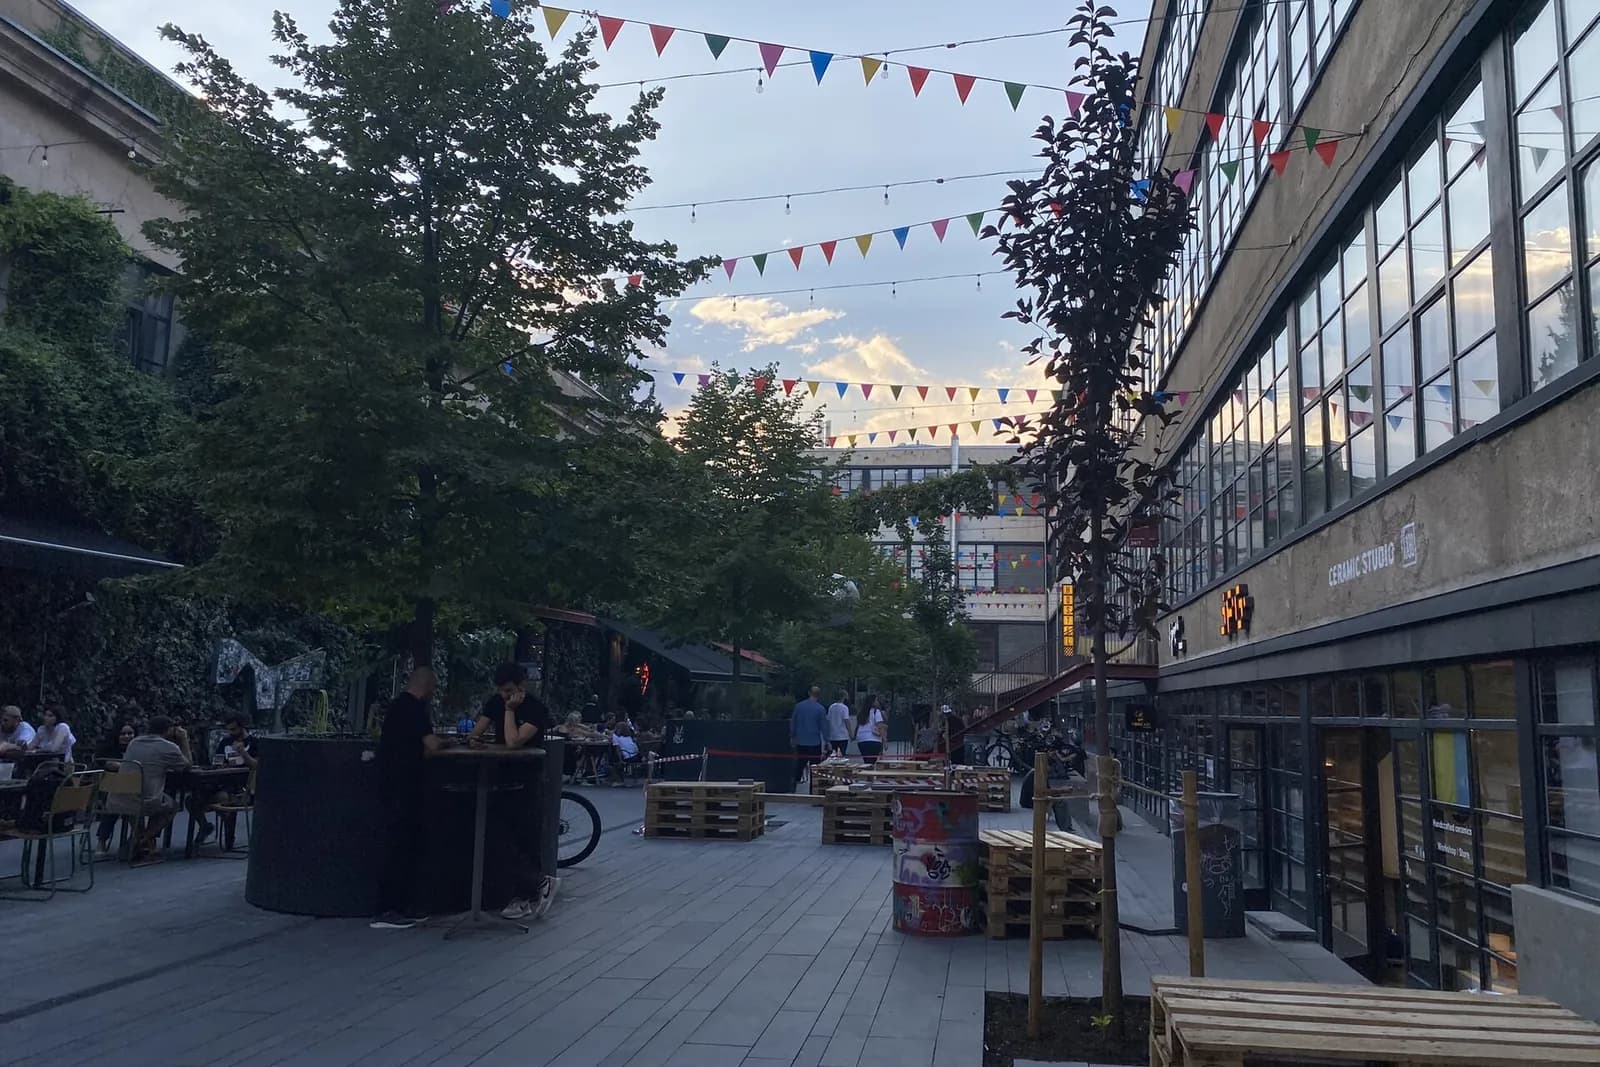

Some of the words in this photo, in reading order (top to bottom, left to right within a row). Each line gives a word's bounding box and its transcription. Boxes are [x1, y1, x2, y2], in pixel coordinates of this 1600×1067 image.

[1329, 555, 1360, 587] CERAMIC
[1361, 542, 1395, 574] STUDIO
[1064, 586, 1073, 645] HOSTEL
[1432, 818, 1455, 832] Handcrafted
